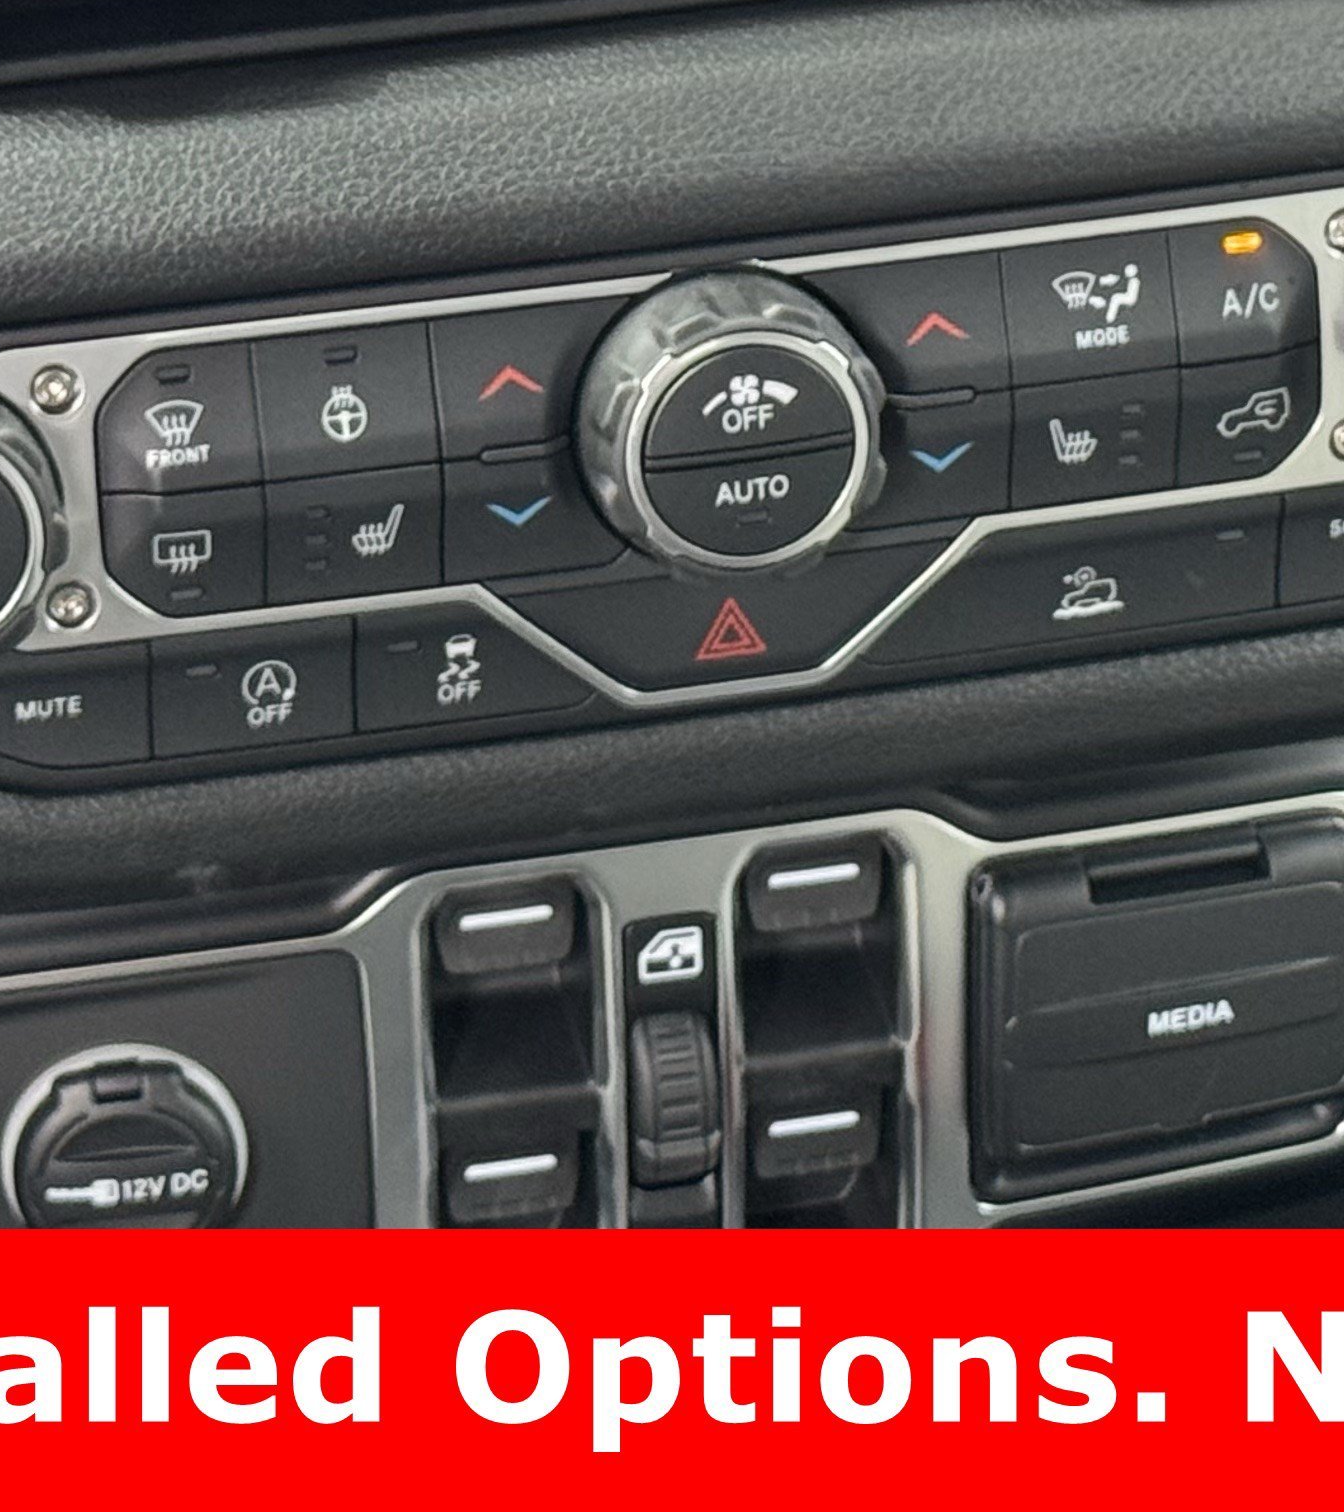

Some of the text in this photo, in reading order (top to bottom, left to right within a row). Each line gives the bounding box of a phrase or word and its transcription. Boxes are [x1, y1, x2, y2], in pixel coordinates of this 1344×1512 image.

[1222, 282, 1281, 319] A/C
[1075, 324, 1131, 351] MODE
[721, 403, 775, 435] OFF
[144, 443, 211, 470] FRONT
[714, 473, 791, 509] AUTO
[436, 680, 481, 705] OFF
[14, 695, 84, 721] MUTE
[246, 703, 294, 728] OFF
[1147, 997, 1235, 1039] MEDIA
[120, 1169, 210, 1204] 12V DC
